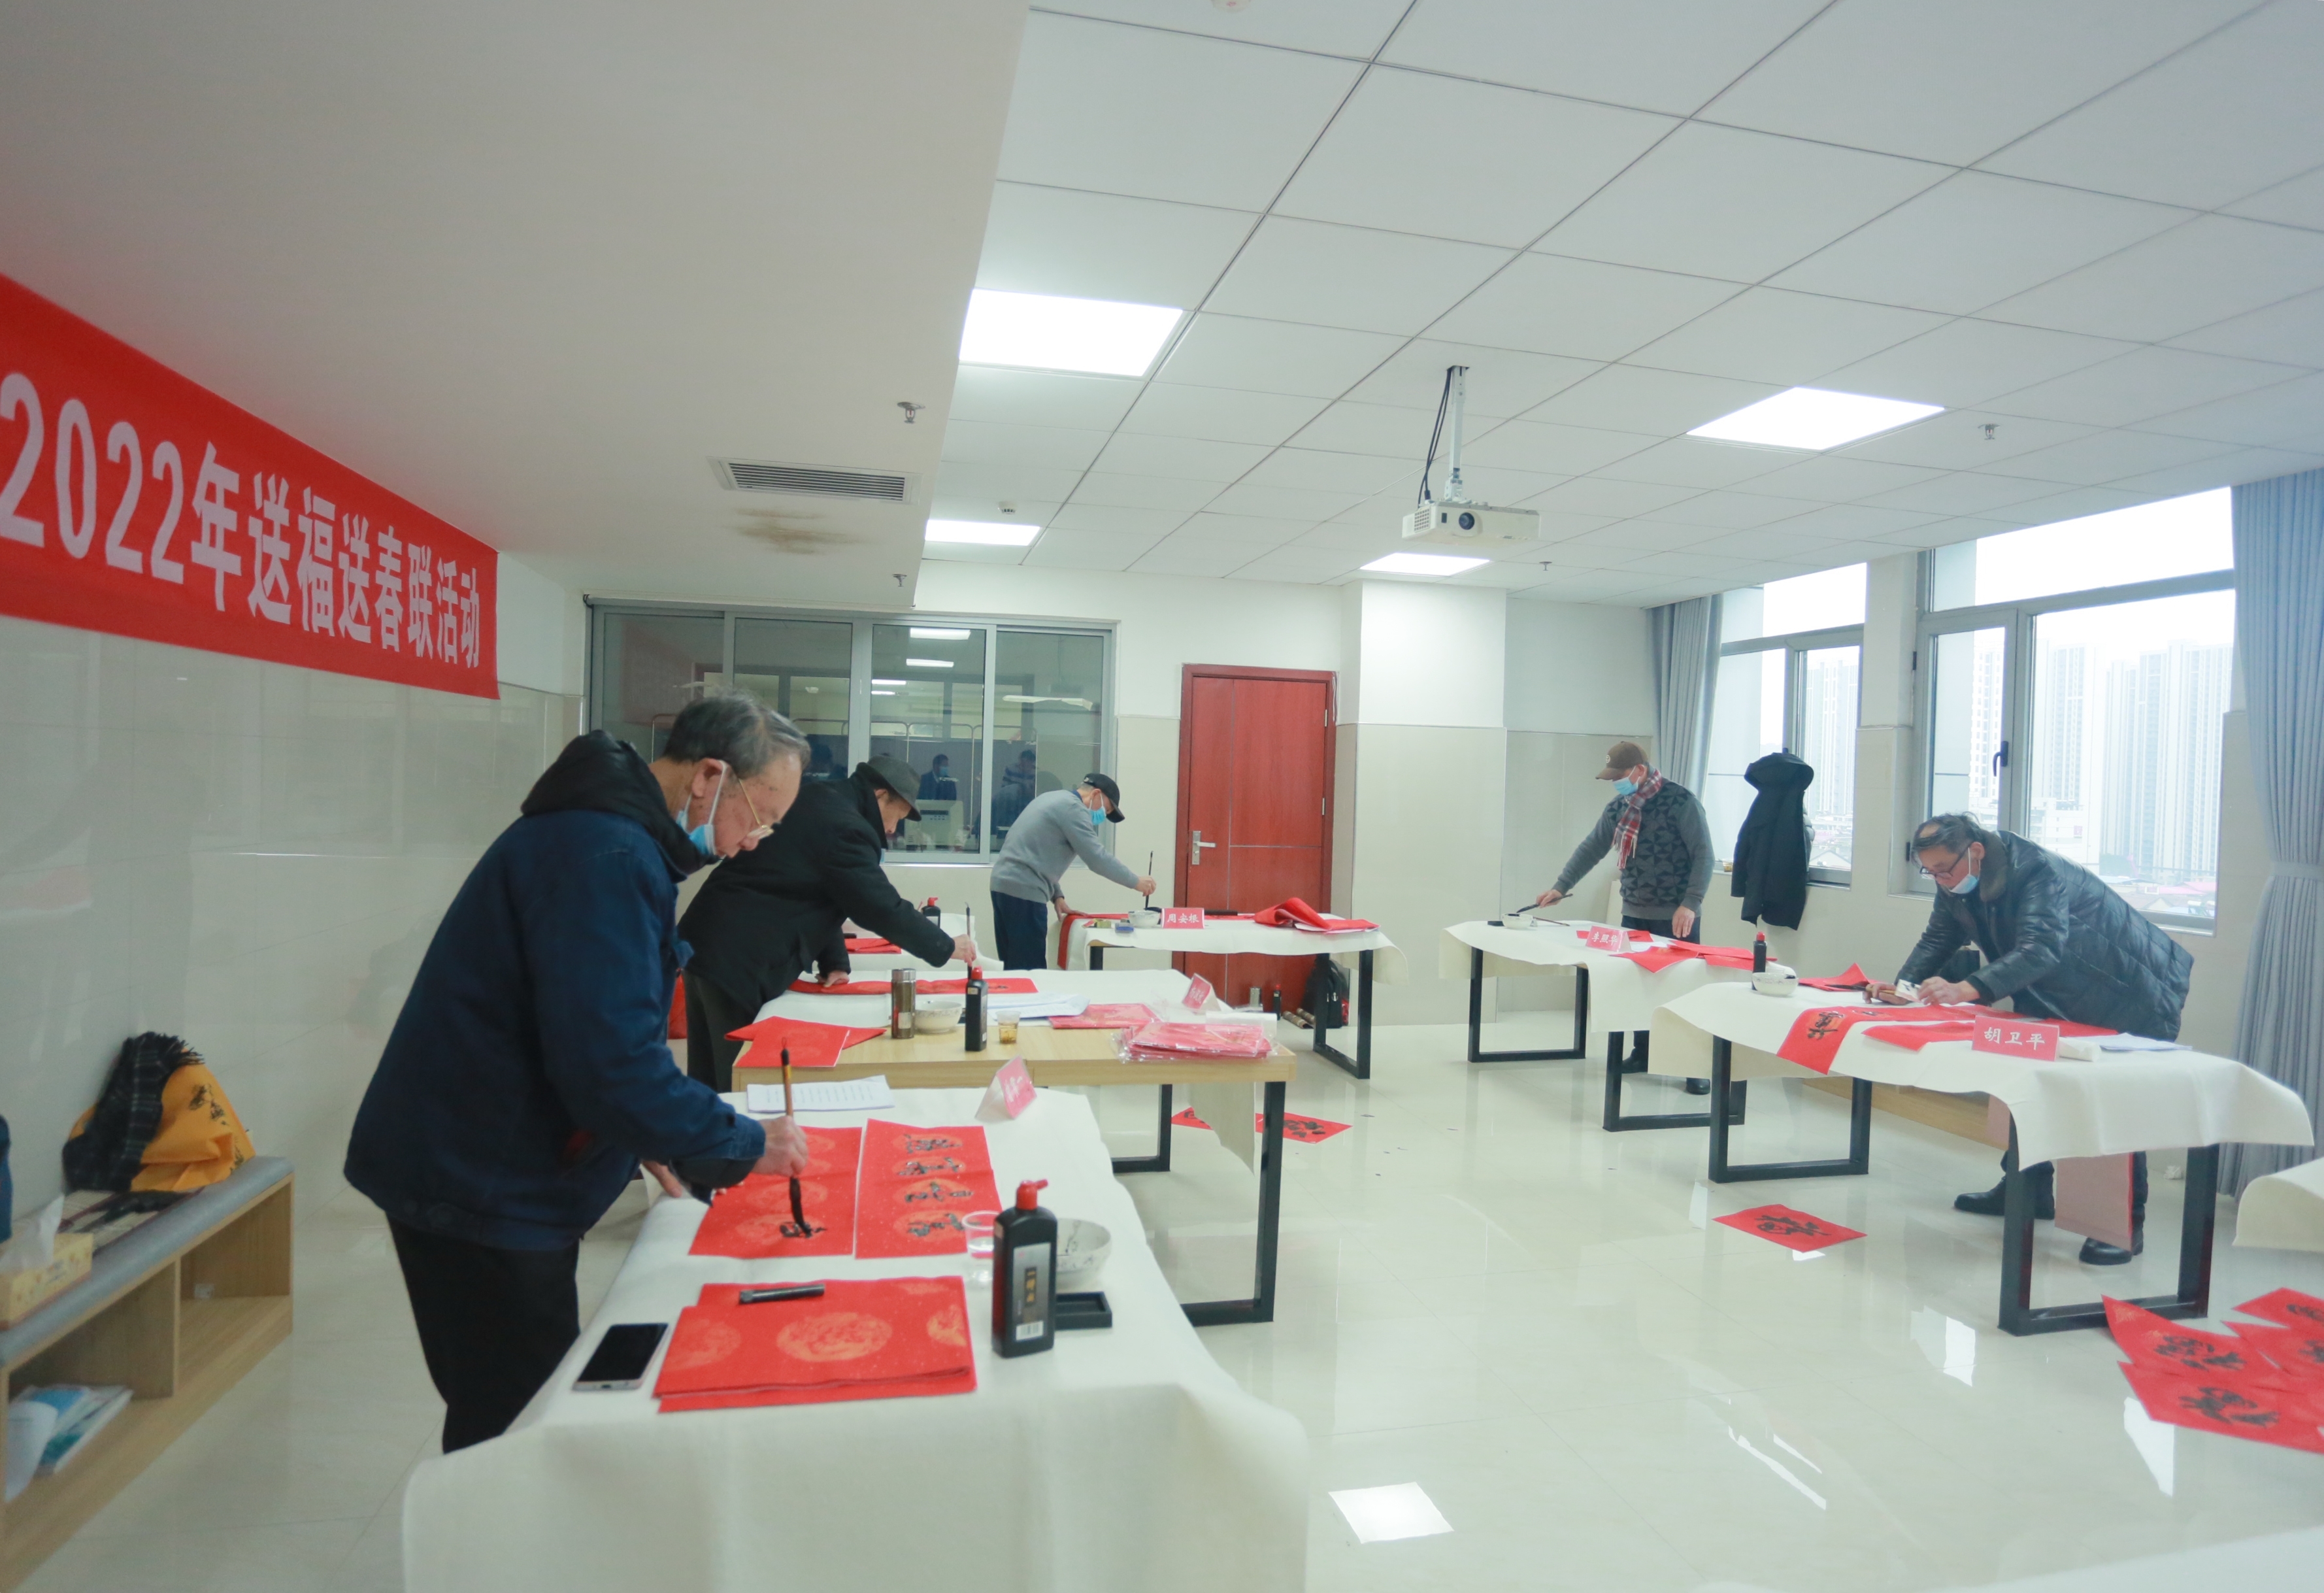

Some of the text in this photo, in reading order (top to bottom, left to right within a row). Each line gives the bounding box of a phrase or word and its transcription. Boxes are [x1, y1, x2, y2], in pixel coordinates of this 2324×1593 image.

[0, 372, 480, 669] 2022年送福送春联活动
[1984, 1026, 2046, 1051] 胡卫平
